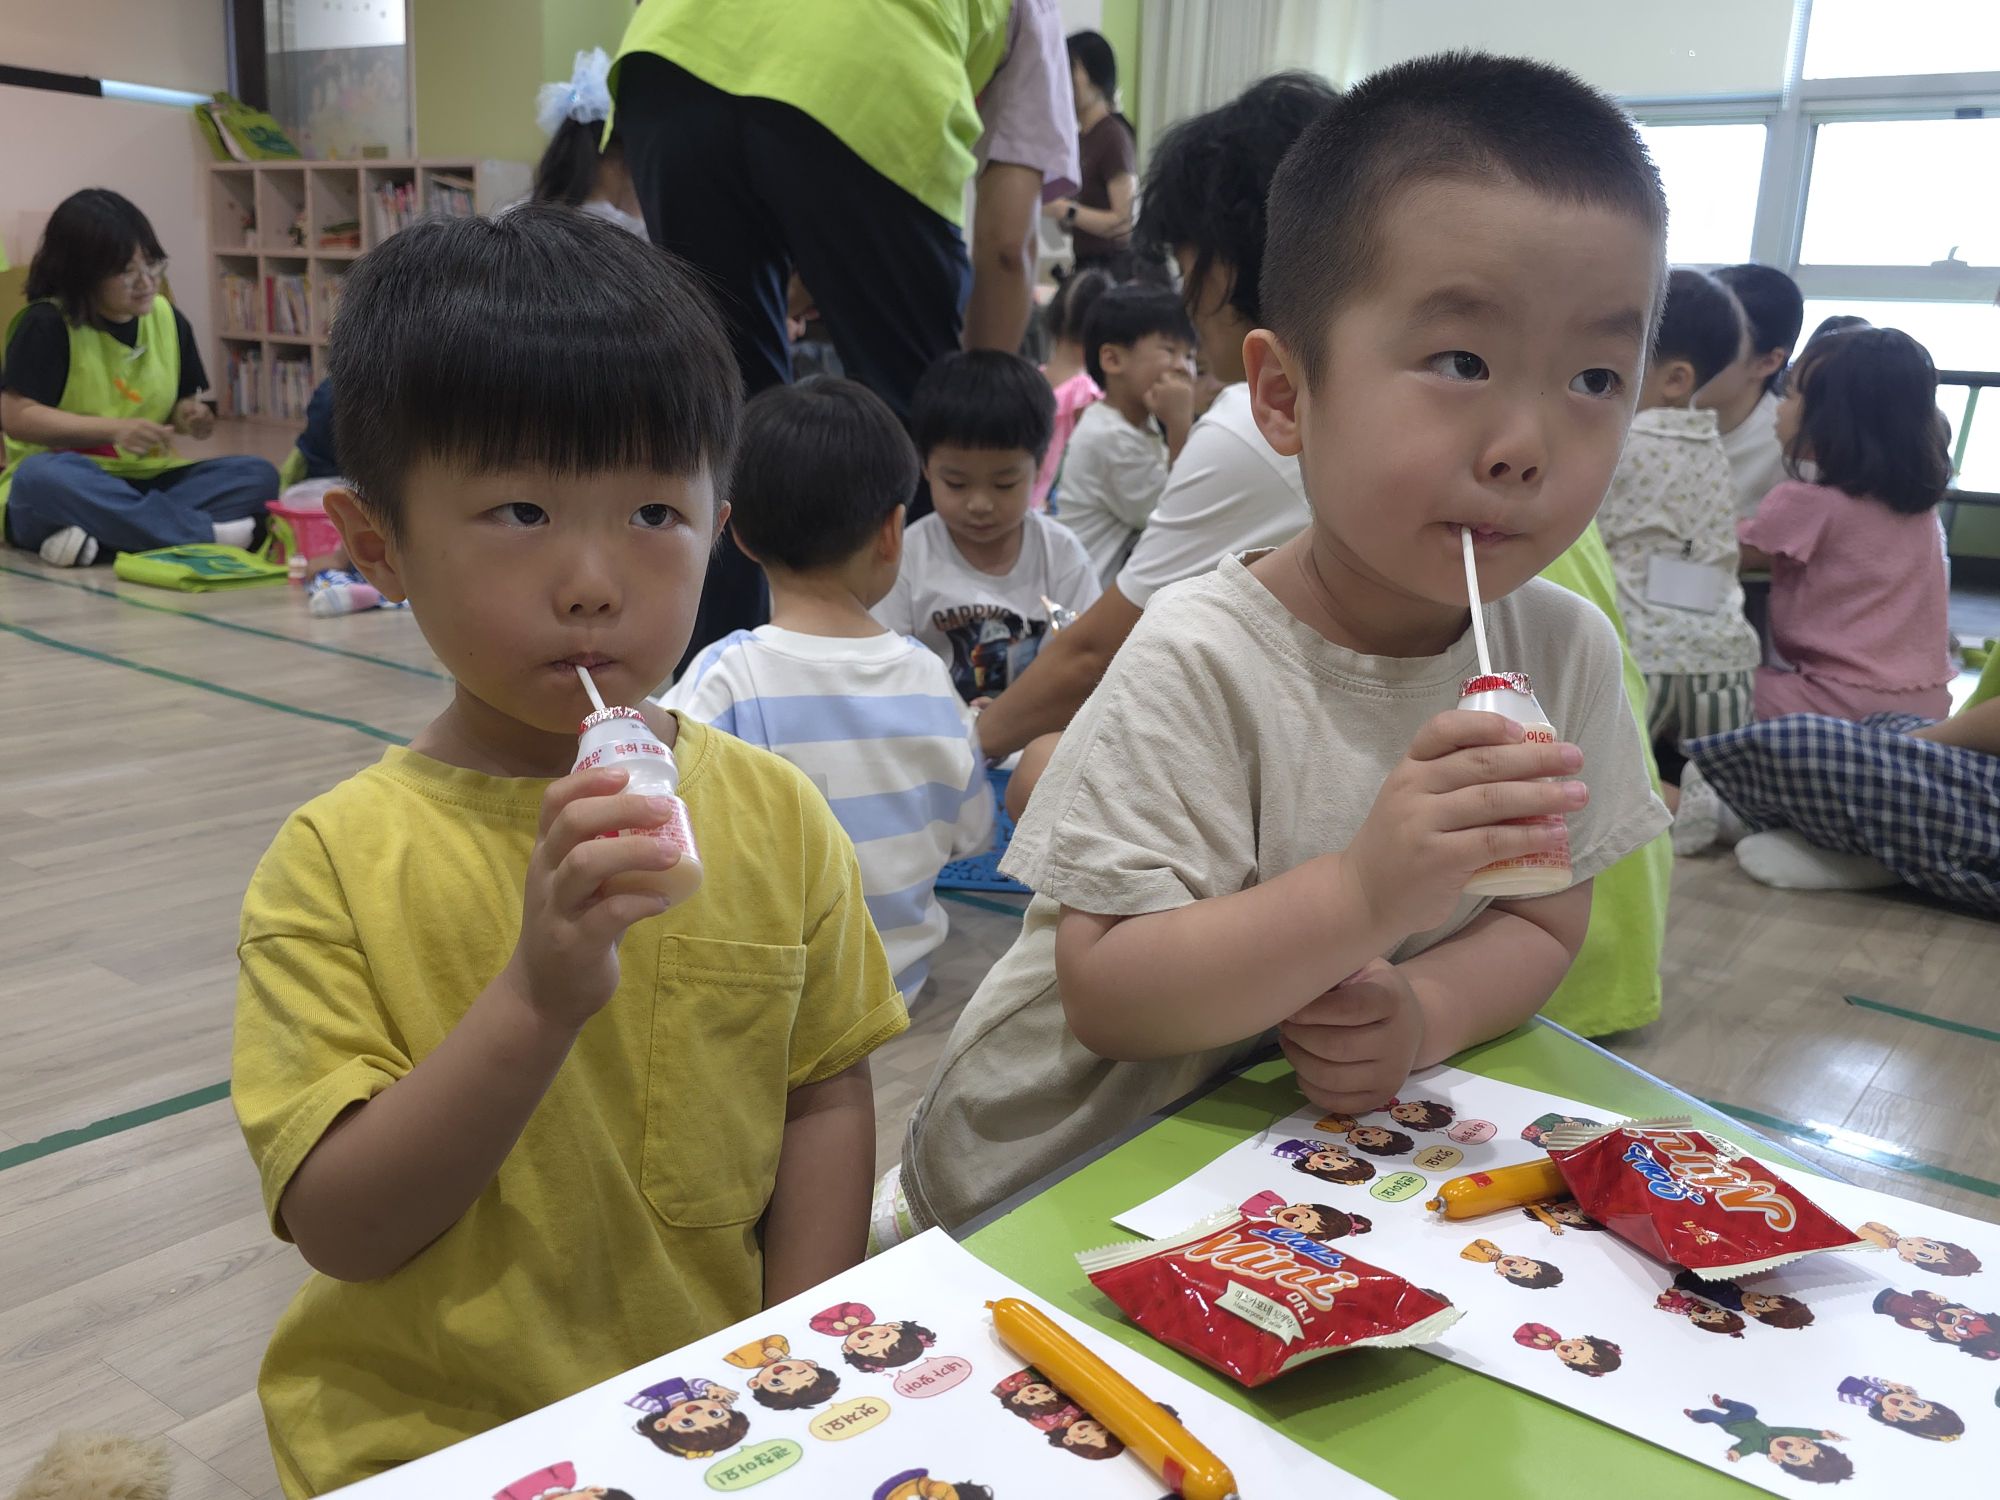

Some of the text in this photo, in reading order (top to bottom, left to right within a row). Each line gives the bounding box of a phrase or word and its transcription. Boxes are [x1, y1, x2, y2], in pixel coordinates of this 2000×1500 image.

[1421, 1148, 1455, 1169] 멋져요!
[1377, 1175, 1418, 1199] 괜찮아요!
[1185, 1232, 1359, 1309] Mini
[819, 1403, 879, 1436] 멋져요!
[713, 1446, 792, 1486] 괜찮아요!
